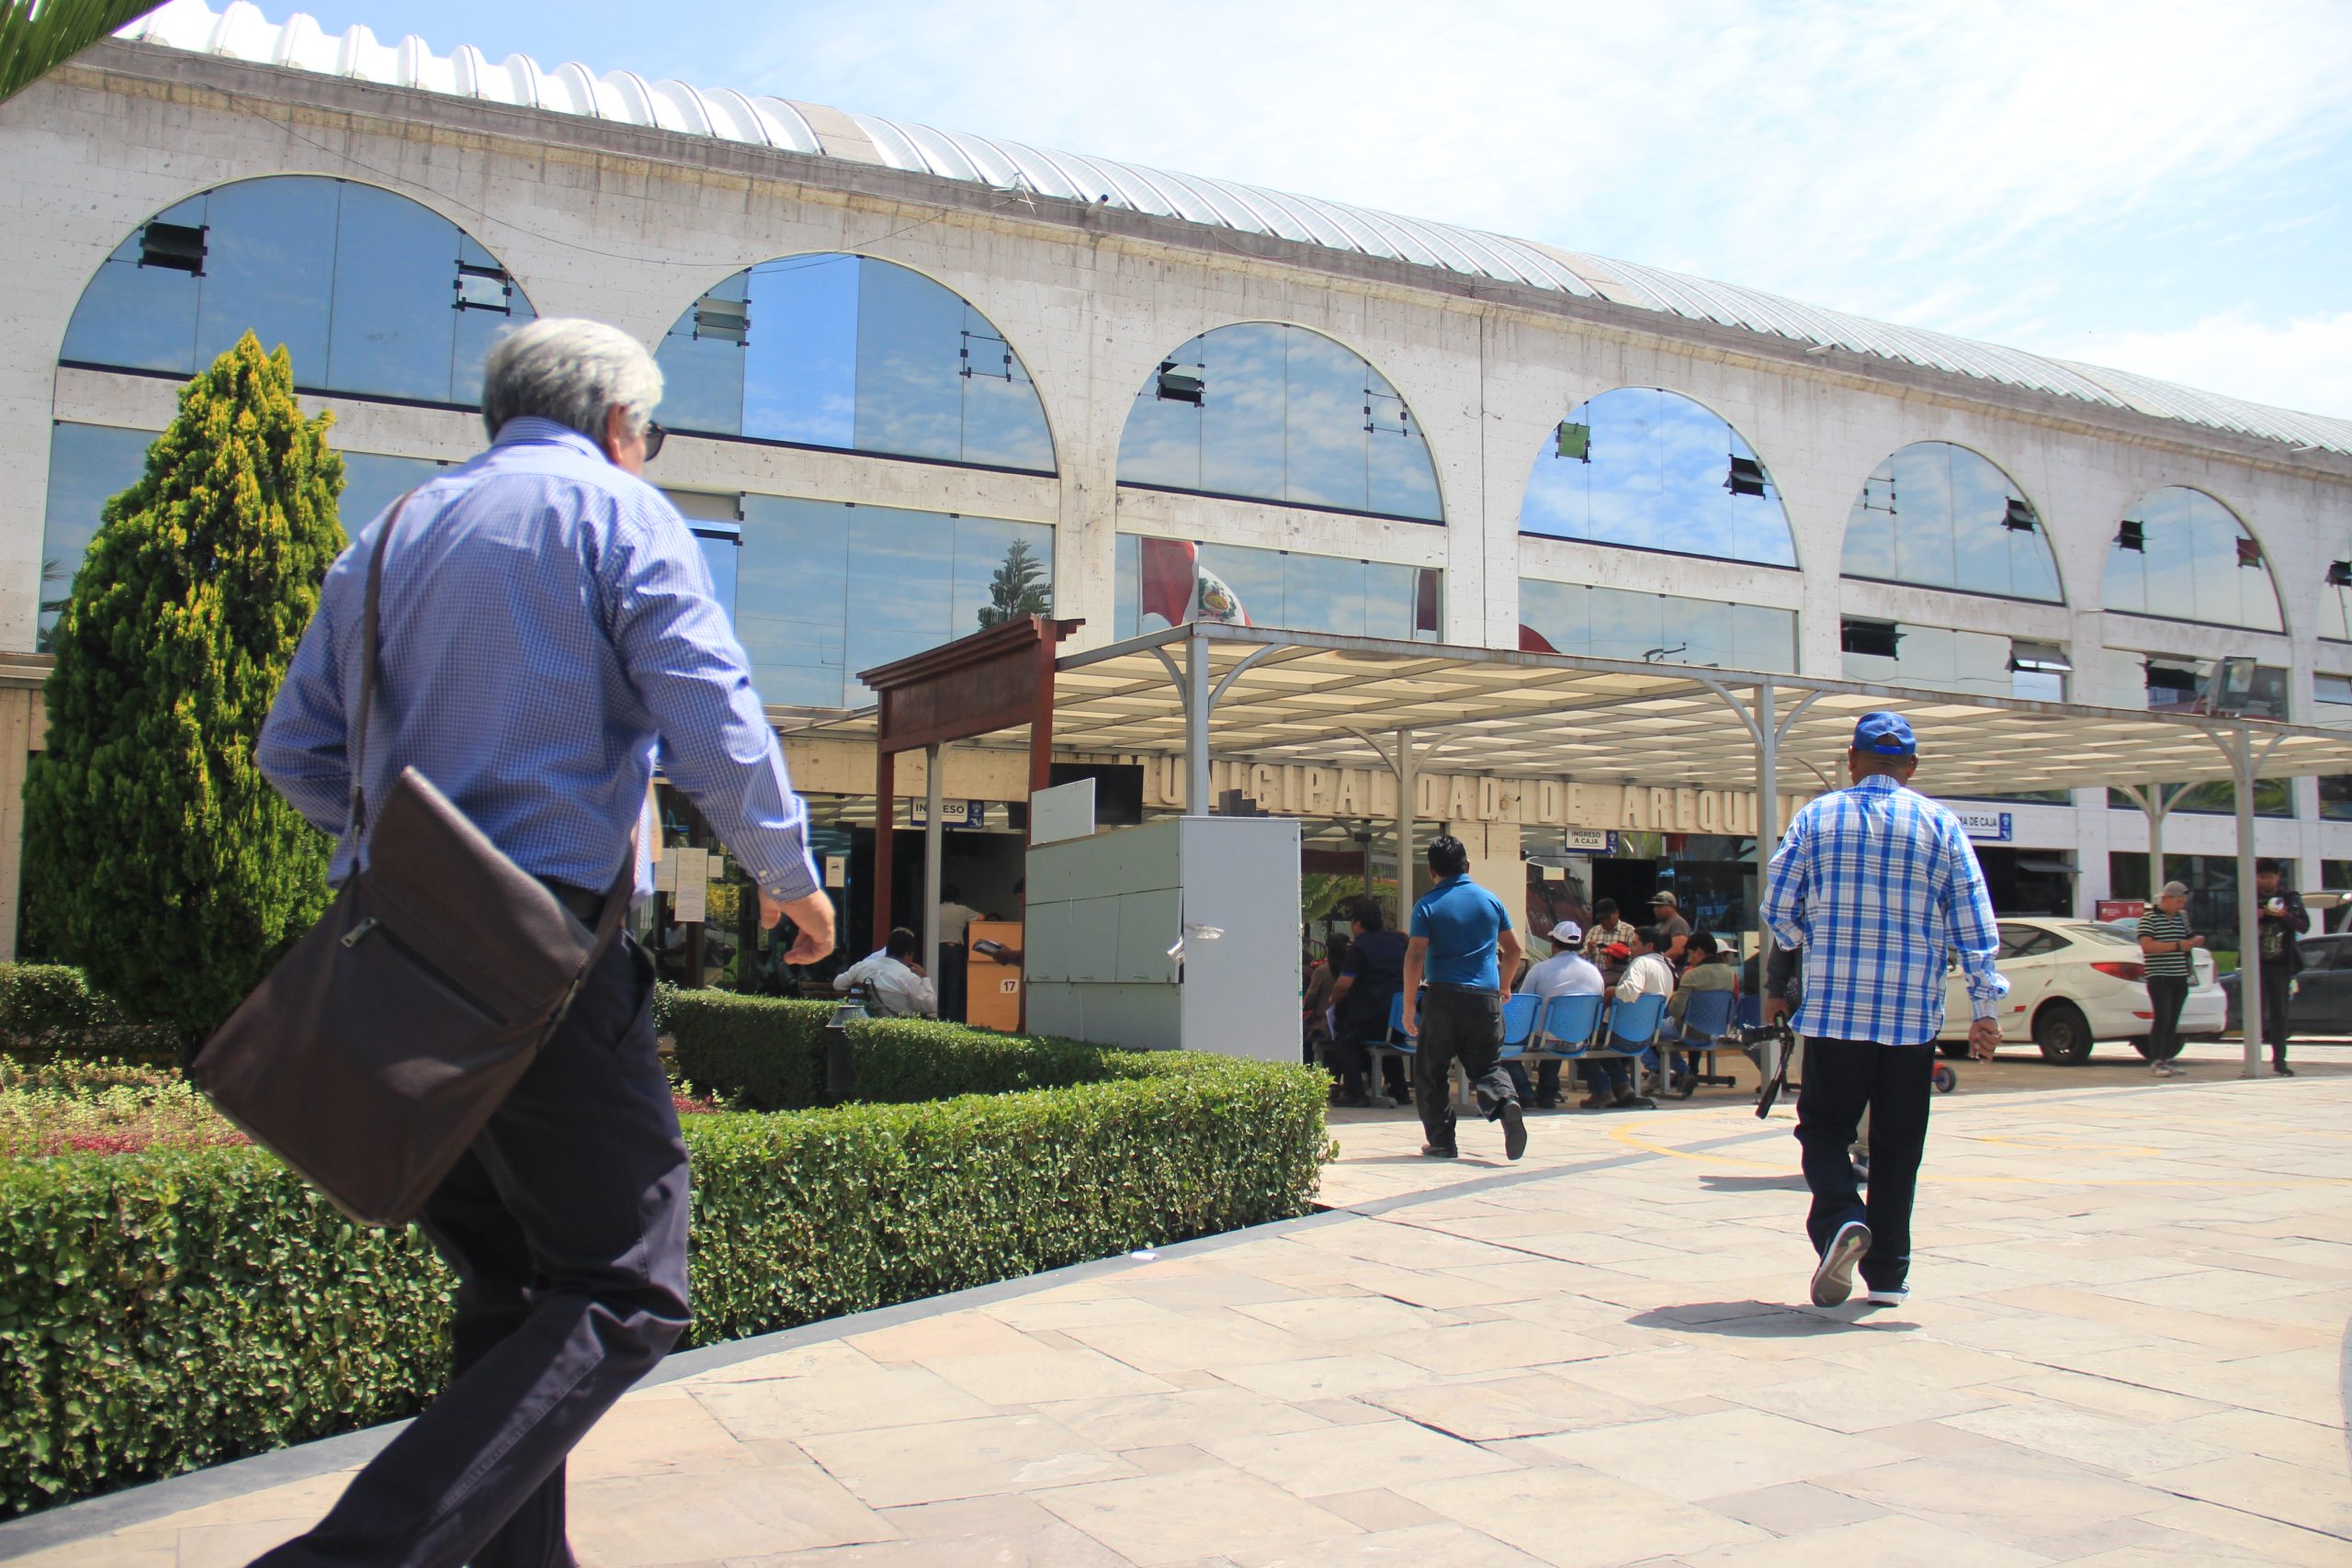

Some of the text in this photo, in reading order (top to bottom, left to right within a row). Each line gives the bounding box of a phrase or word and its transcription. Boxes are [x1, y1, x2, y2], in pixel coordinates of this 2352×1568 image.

[916, 803, 965, 814] INESO
[1539, 781, 1582, 825] DE
[1622, 785, 1804, 834] AREQUI
[1969, 816, 1978, 827] DE
[1980, 817, 1997, 827] CAJA
[1003, 981, 1016, 991] 17
